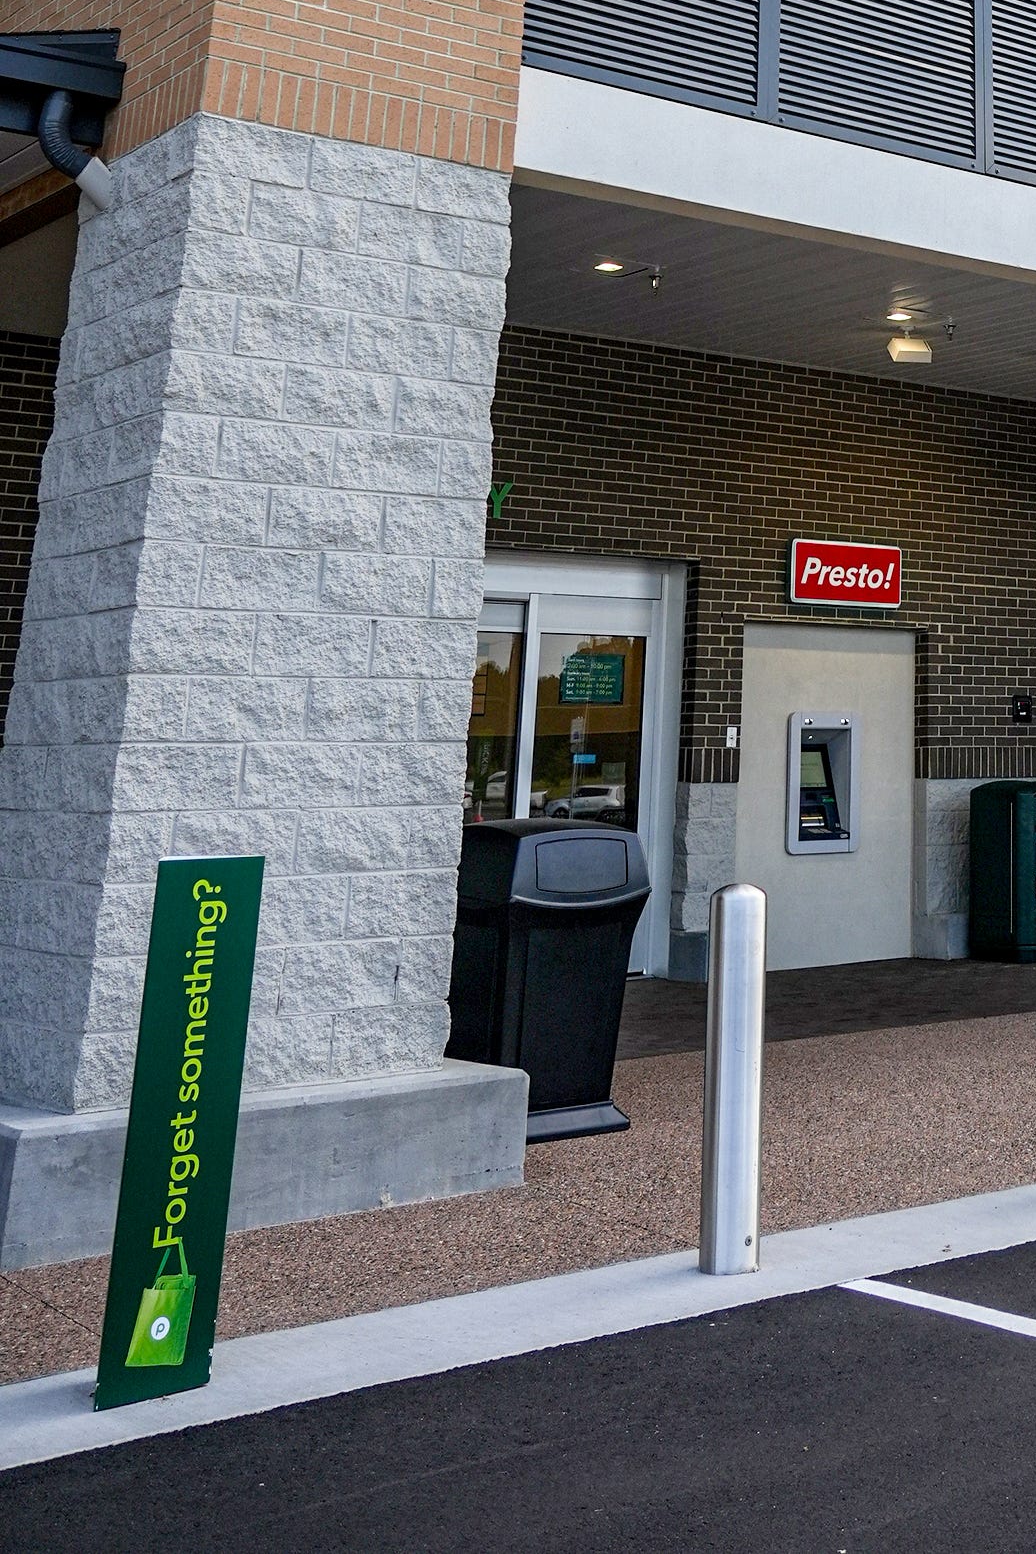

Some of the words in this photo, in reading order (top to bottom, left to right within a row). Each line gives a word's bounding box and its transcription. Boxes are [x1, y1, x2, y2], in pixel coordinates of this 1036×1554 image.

[801, 556, 895, 590] Presto!
[153, 1110, 200, 1249] Forget
[178, 878, 228, 1102] something?
